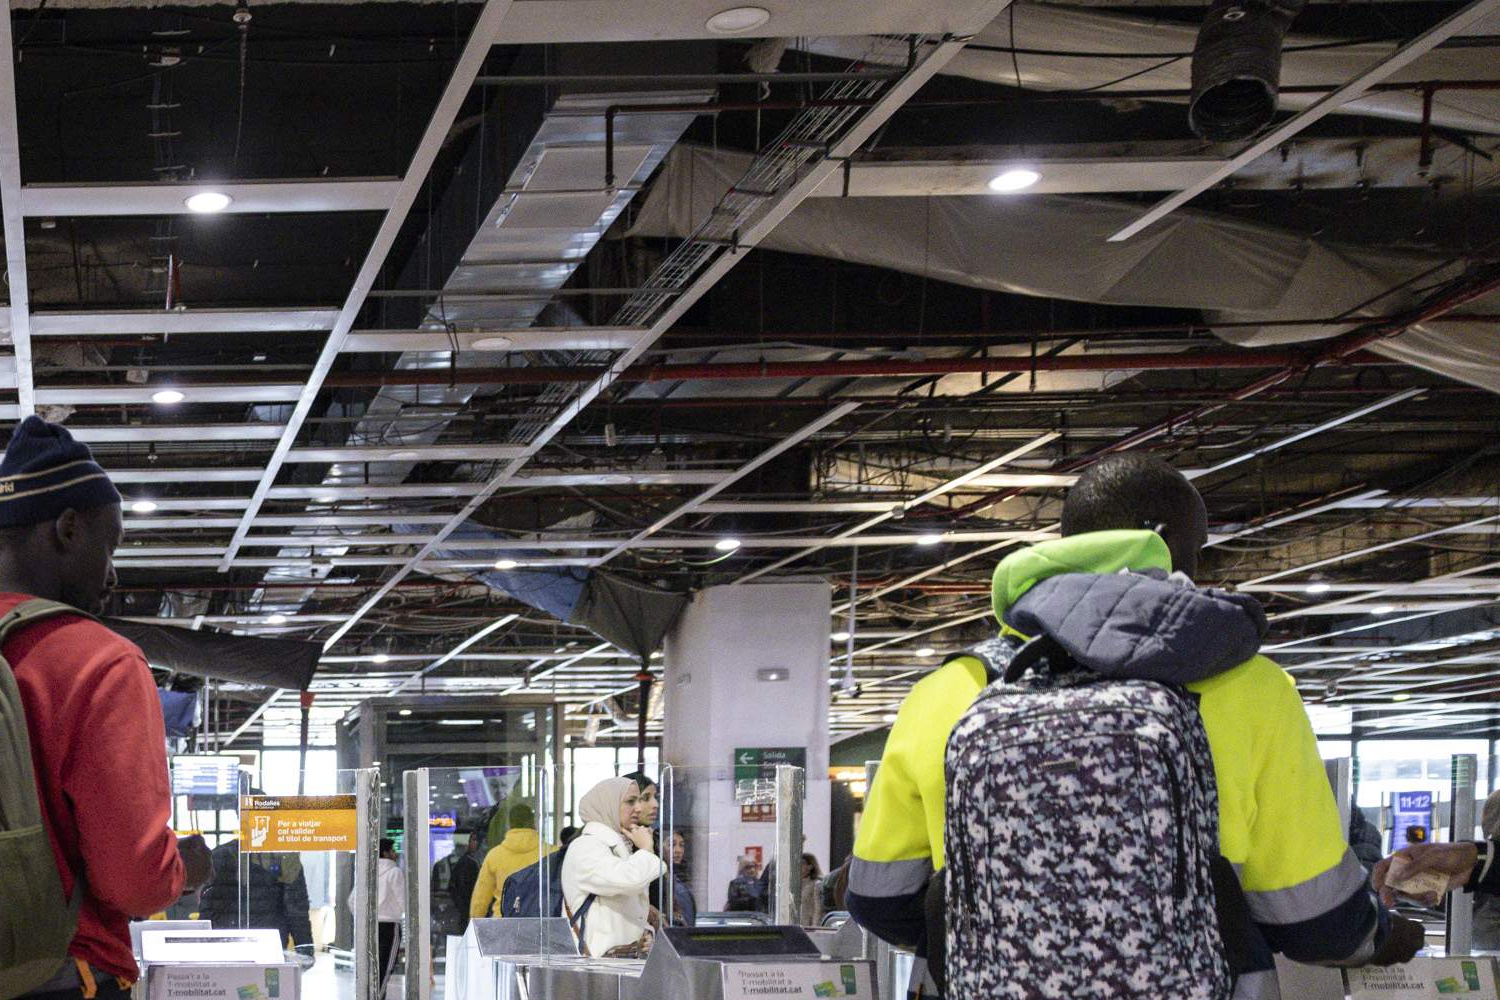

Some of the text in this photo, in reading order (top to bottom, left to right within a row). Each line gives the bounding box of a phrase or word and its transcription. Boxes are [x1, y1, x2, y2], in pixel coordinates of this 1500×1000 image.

[1401, 795, 1431, 808] 11-12
[167, 989, 227, 997] T-mobilitat.cat
[742, 986, 803, 994] T-mobilitat.cat
